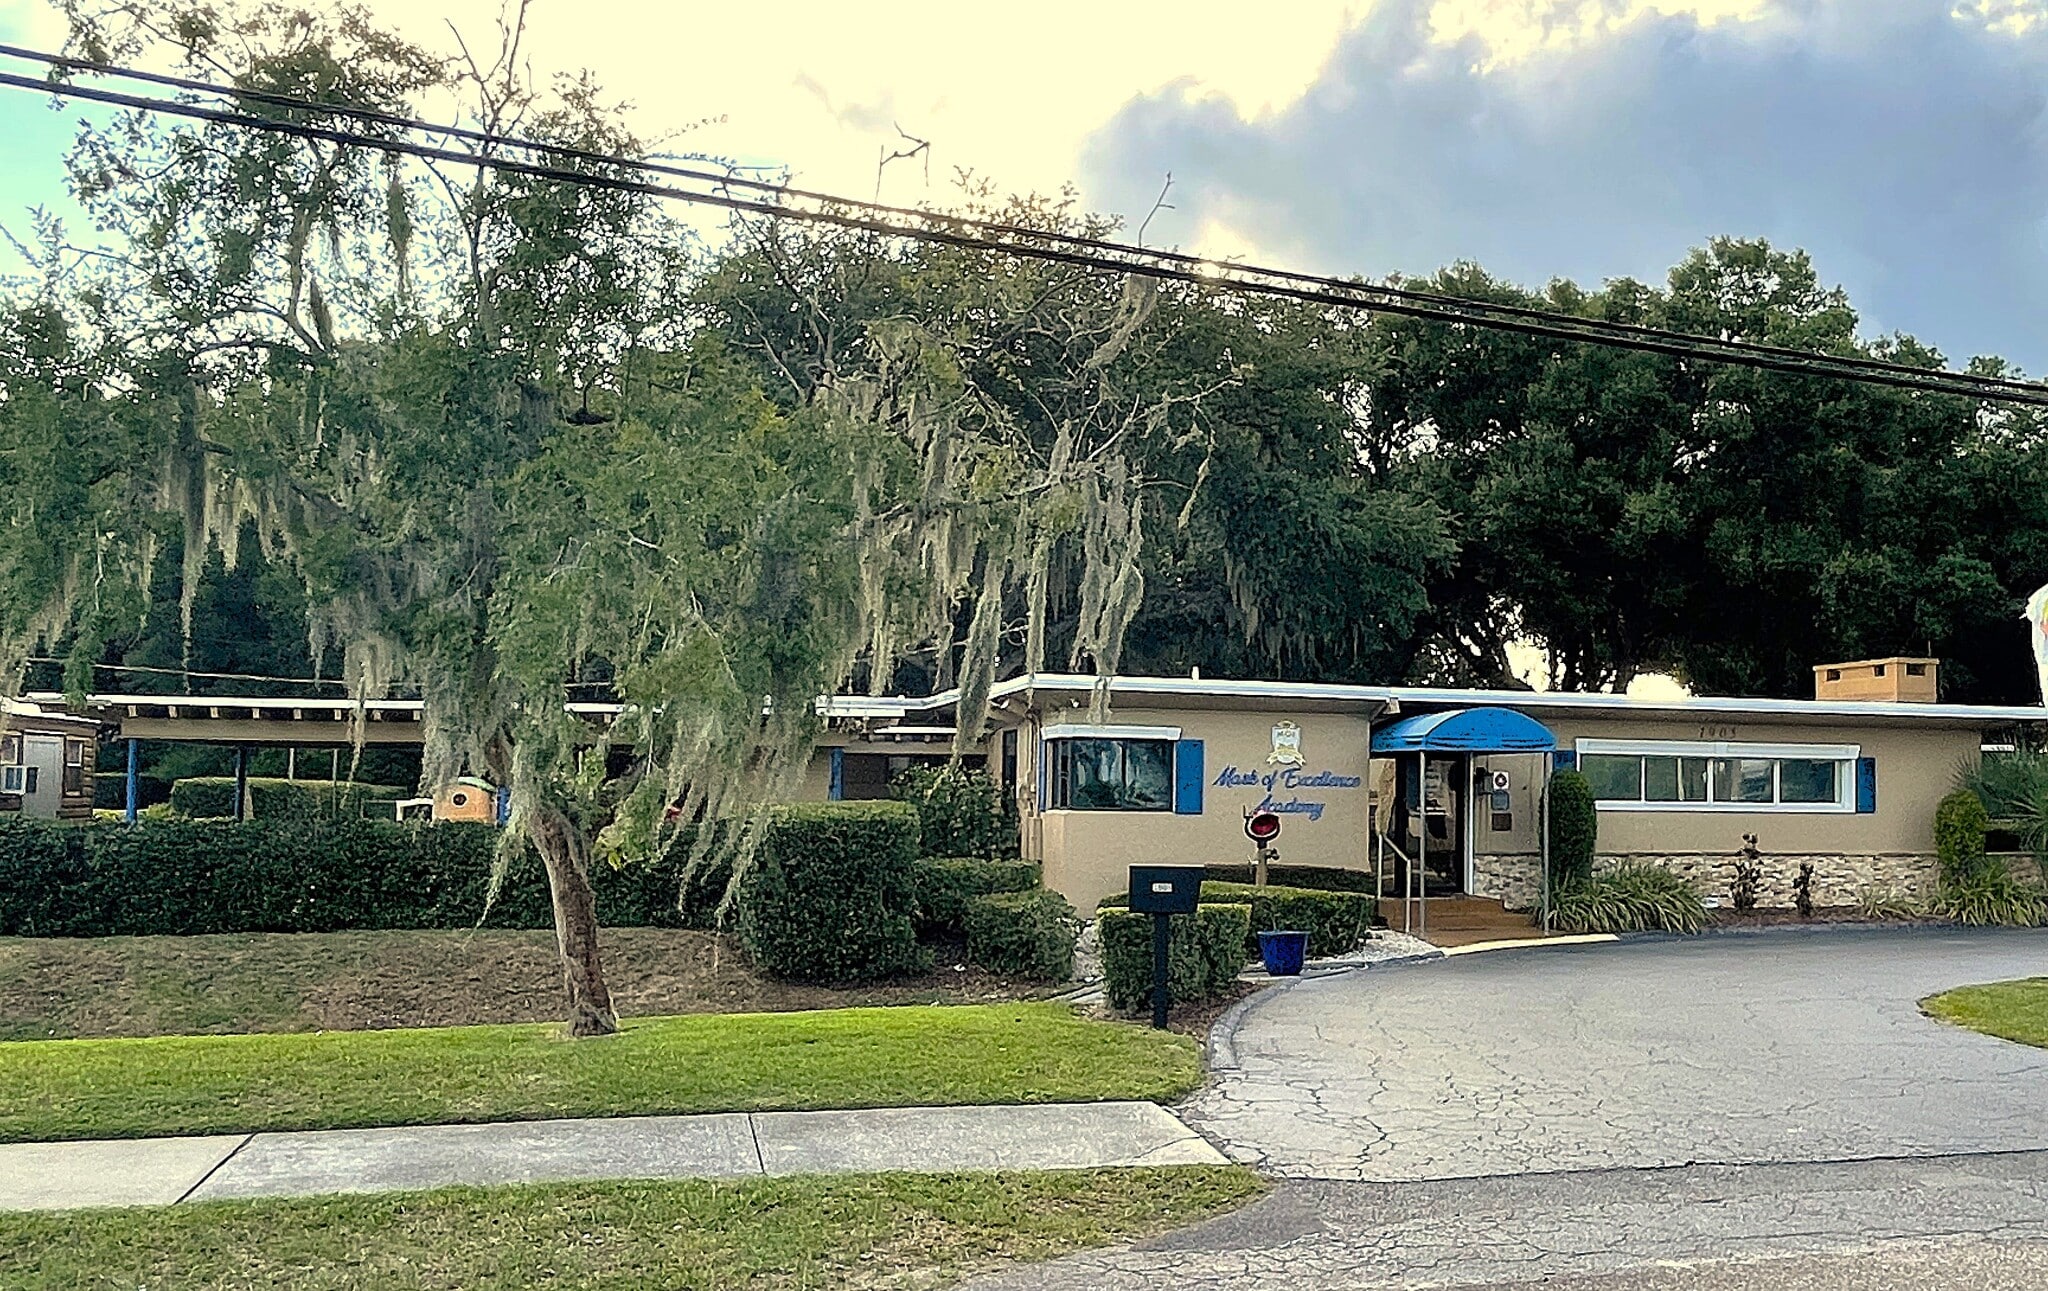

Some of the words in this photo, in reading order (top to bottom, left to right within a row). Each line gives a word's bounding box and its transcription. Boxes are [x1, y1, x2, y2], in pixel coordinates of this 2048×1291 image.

[1212, 764, 1259, 788] Mark
[1261, 769, 1278, 792] of
[1280, 767, 1361, 788] Excellence
[1249, 794, 1326, 821] Academy
